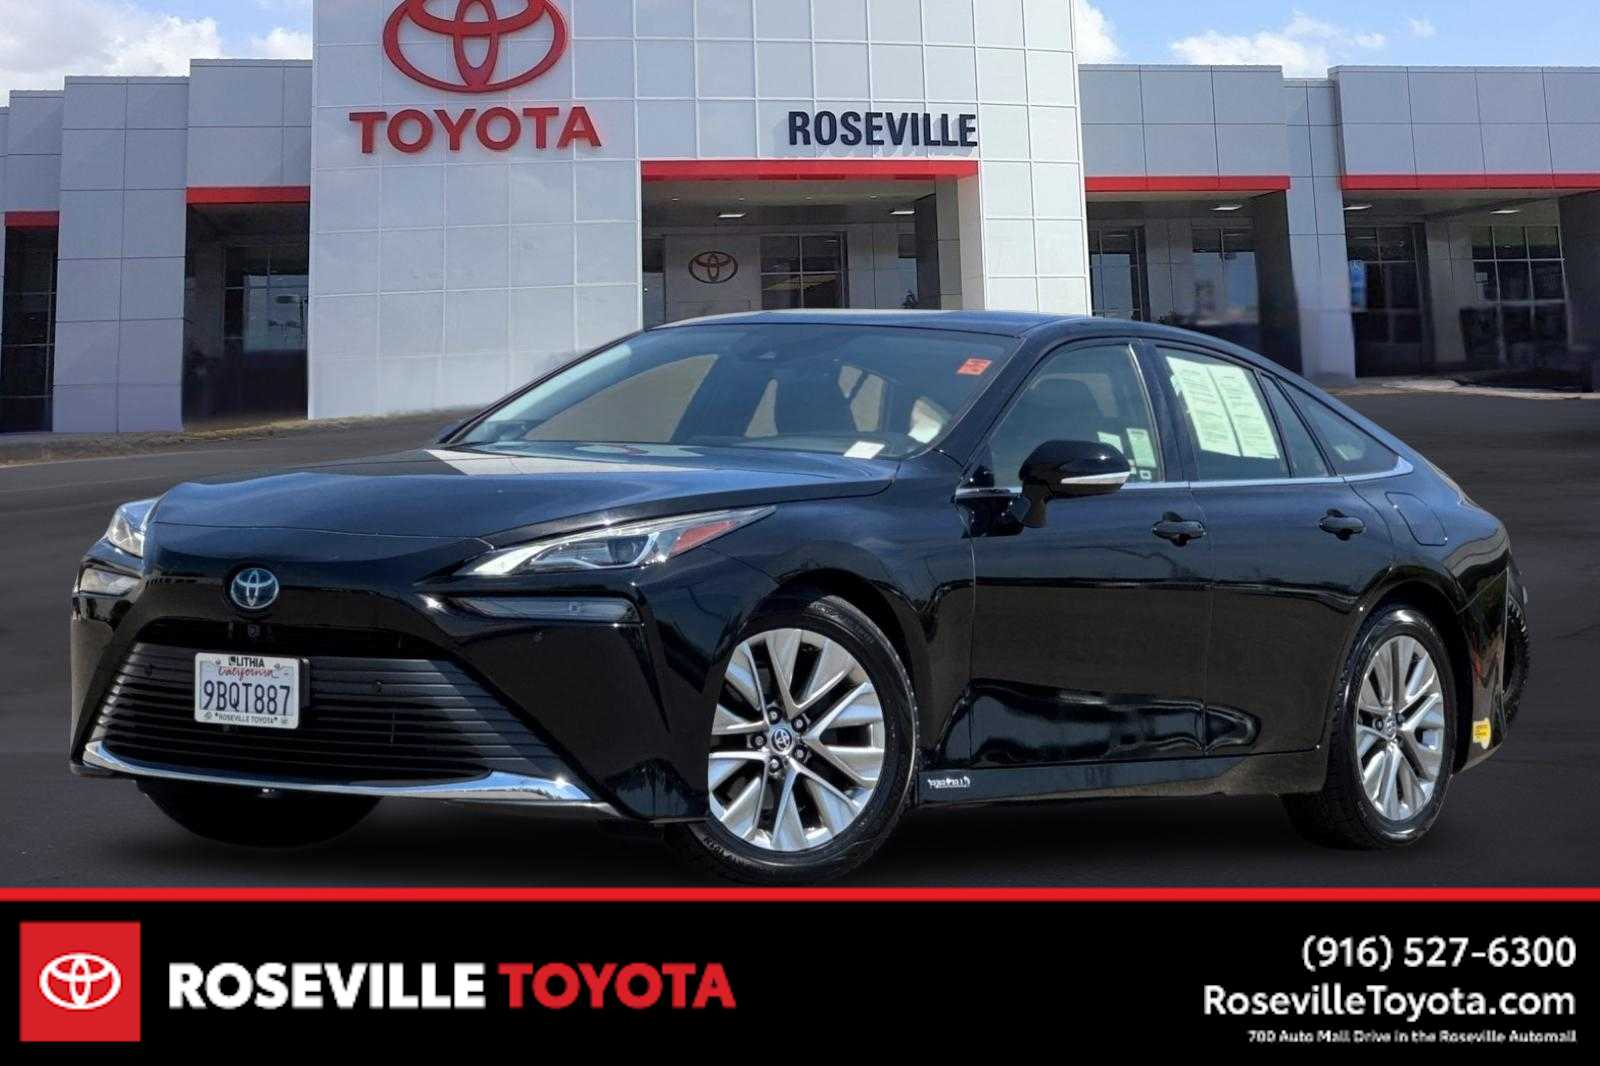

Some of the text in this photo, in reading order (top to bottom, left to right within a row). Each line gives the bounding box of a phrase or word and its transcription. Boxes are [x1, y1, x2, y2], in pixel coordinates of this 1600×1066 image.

[349, 106, 602, 154] TOYOTA
[788, 110, 978, 147] ROSEVILLE
[218, 665, 273, 681] California
[236, 656, 265, 668] LITHIA
[203, 680, 290, 716] 9BQT887
[218, 714, 274, 725] ROSEVILLE TOYOTA
